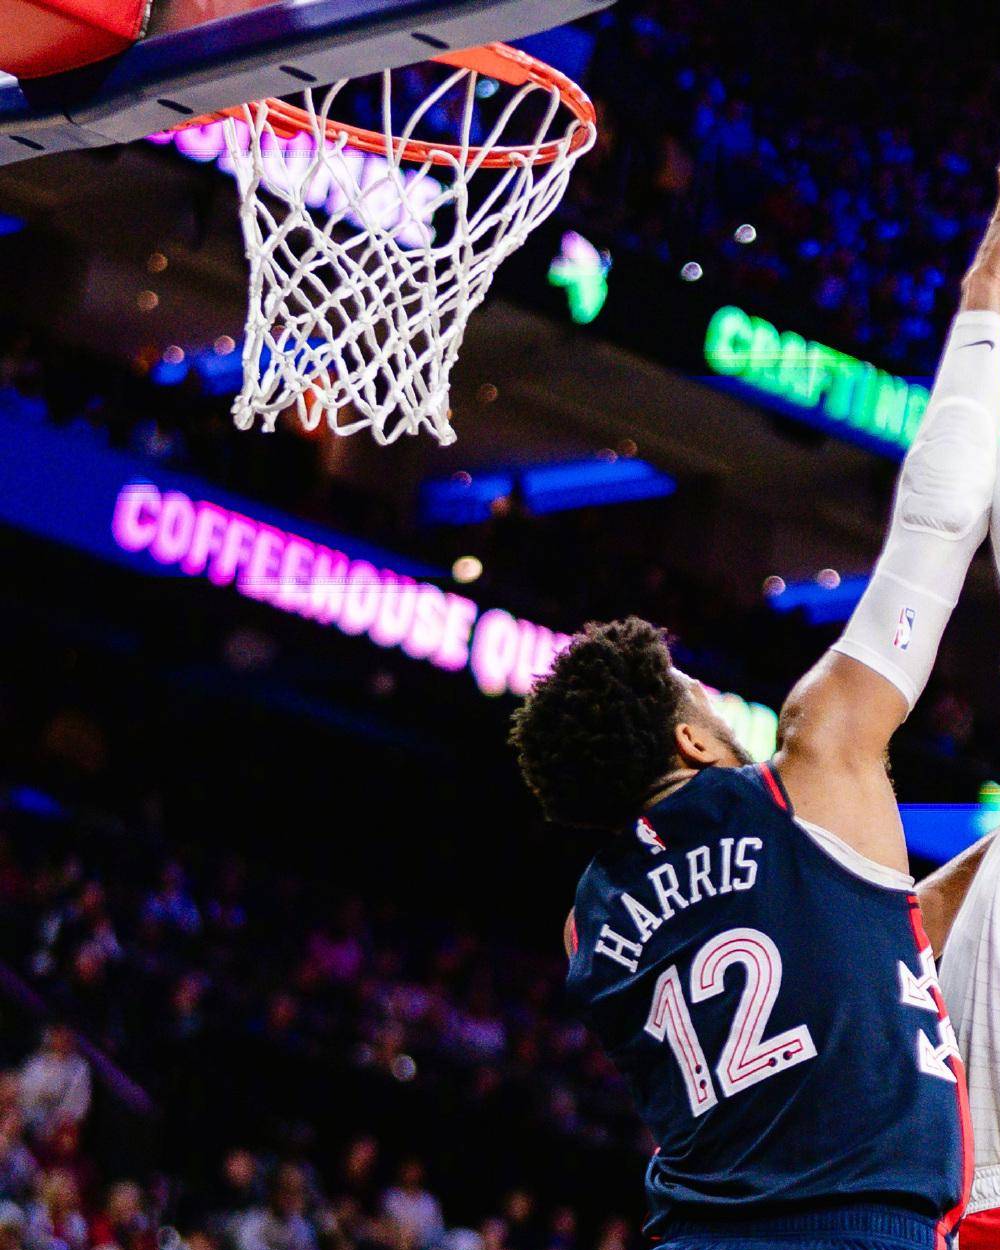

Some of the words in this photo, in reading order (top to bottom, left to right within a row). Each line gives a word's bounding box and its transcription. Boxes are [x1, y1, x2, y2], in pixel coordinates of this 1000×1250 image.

[112, 482, 478, 672] COFFEEHOUSE
[595, 836, 763, 974] HARRIS
[643, 926, 818, 1118] 12
